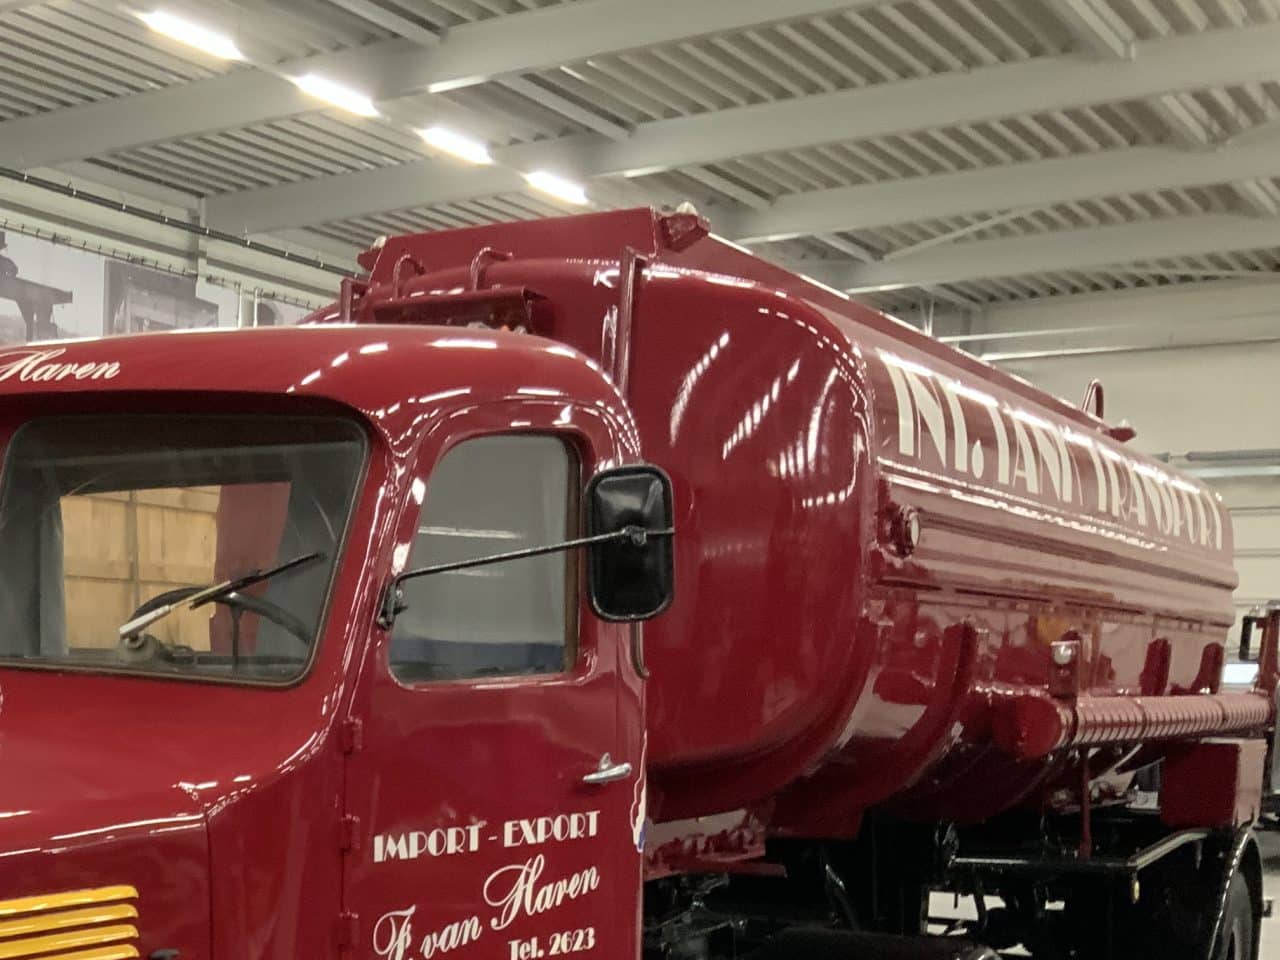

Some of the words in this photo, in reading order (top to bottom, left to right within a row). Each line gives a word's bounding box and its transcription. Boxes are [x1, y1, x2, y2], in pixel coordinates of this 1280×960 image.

[880, 354, 984, 480] INT.
[1080, 440, 1222, 550] TRANSPORT
[374, 824, 482, 863] IMPORT
[504, 810, 600, 848] EXPORT
[420, 916, 482, 959] van
[483, 854, 600, 930] Haren
[549, 927, 596, 955] 2623
